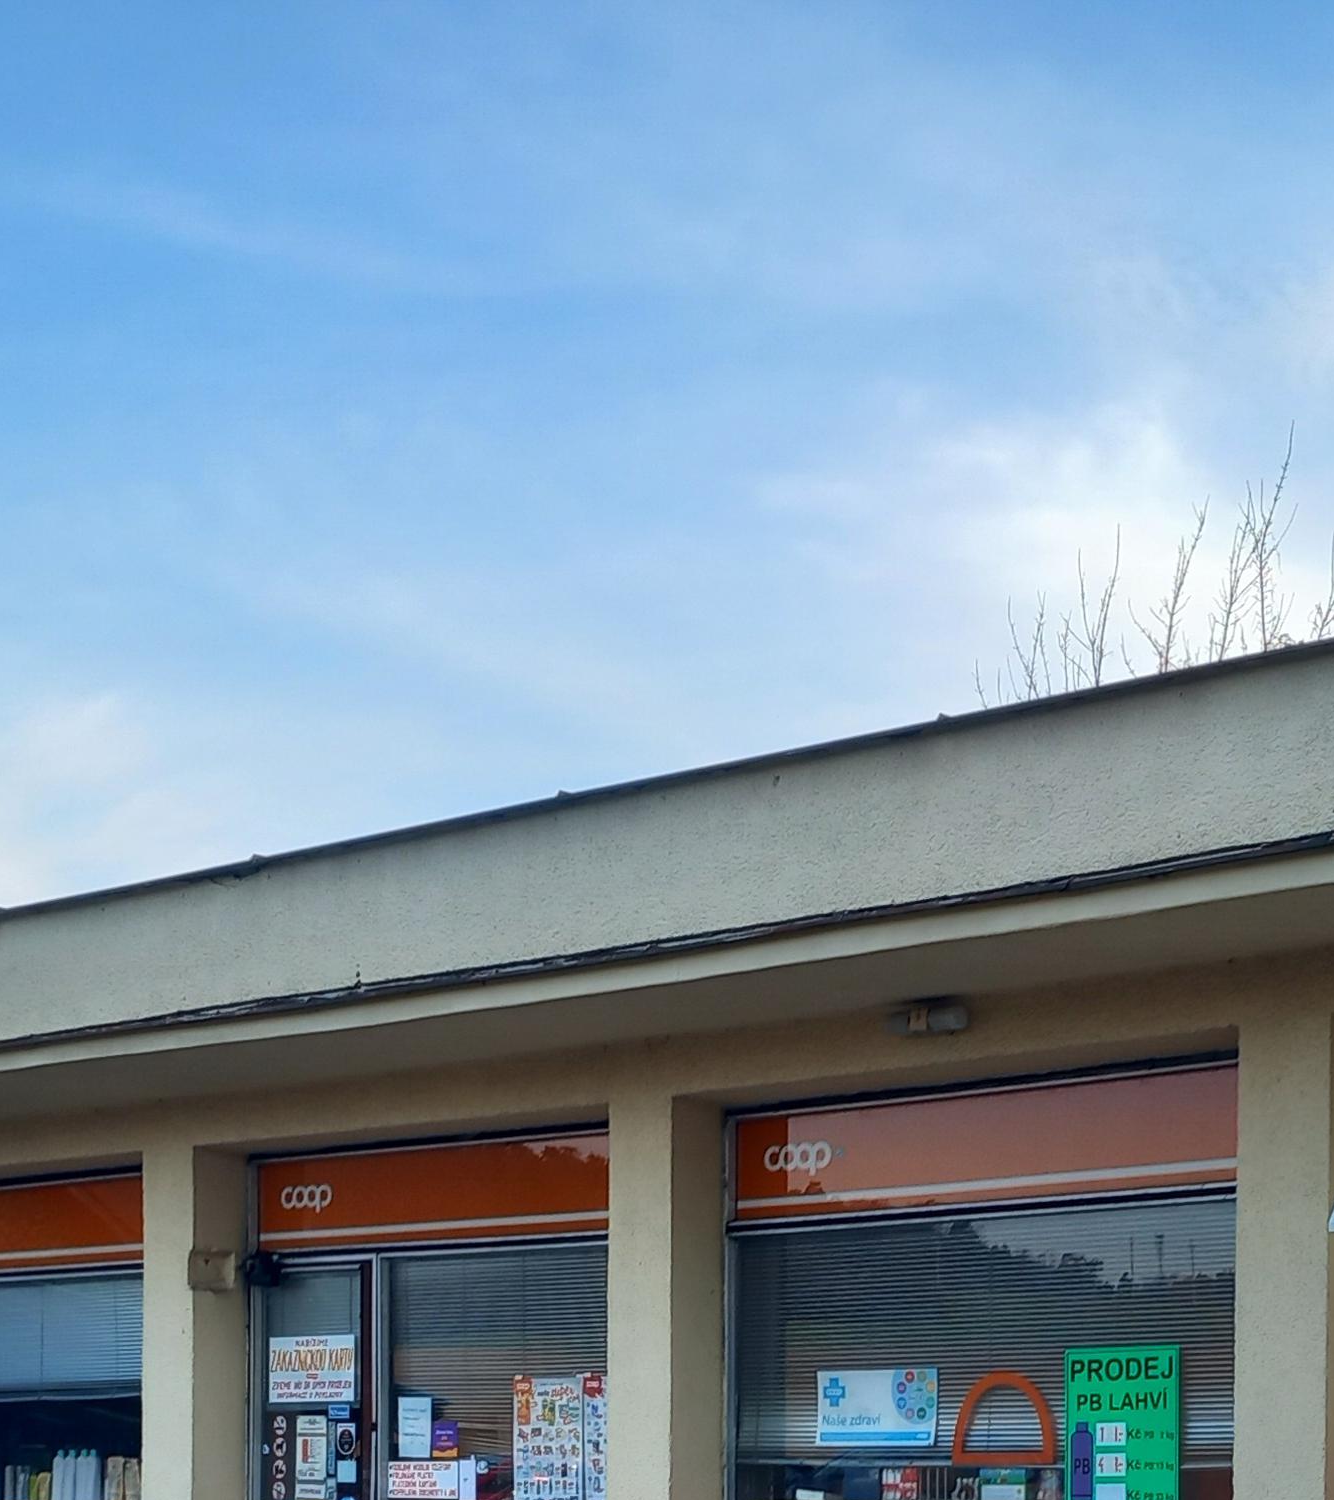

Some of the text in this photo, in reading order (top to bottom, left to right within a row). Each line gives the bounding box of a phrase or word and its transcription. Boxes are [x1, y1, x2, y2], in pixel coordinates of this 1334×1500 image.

[763, 1140, 833, 1177] coop
[280, 1183, 333, 1214] coop
[1070, 1355, 1174, 1383] PRODEJ
[1076, 1387, 1168, 1412] PB LAHVÍ
[822, 1413, 882, 1427] Naše zdraví
[1074, 1457, 1091, 1475] PB
